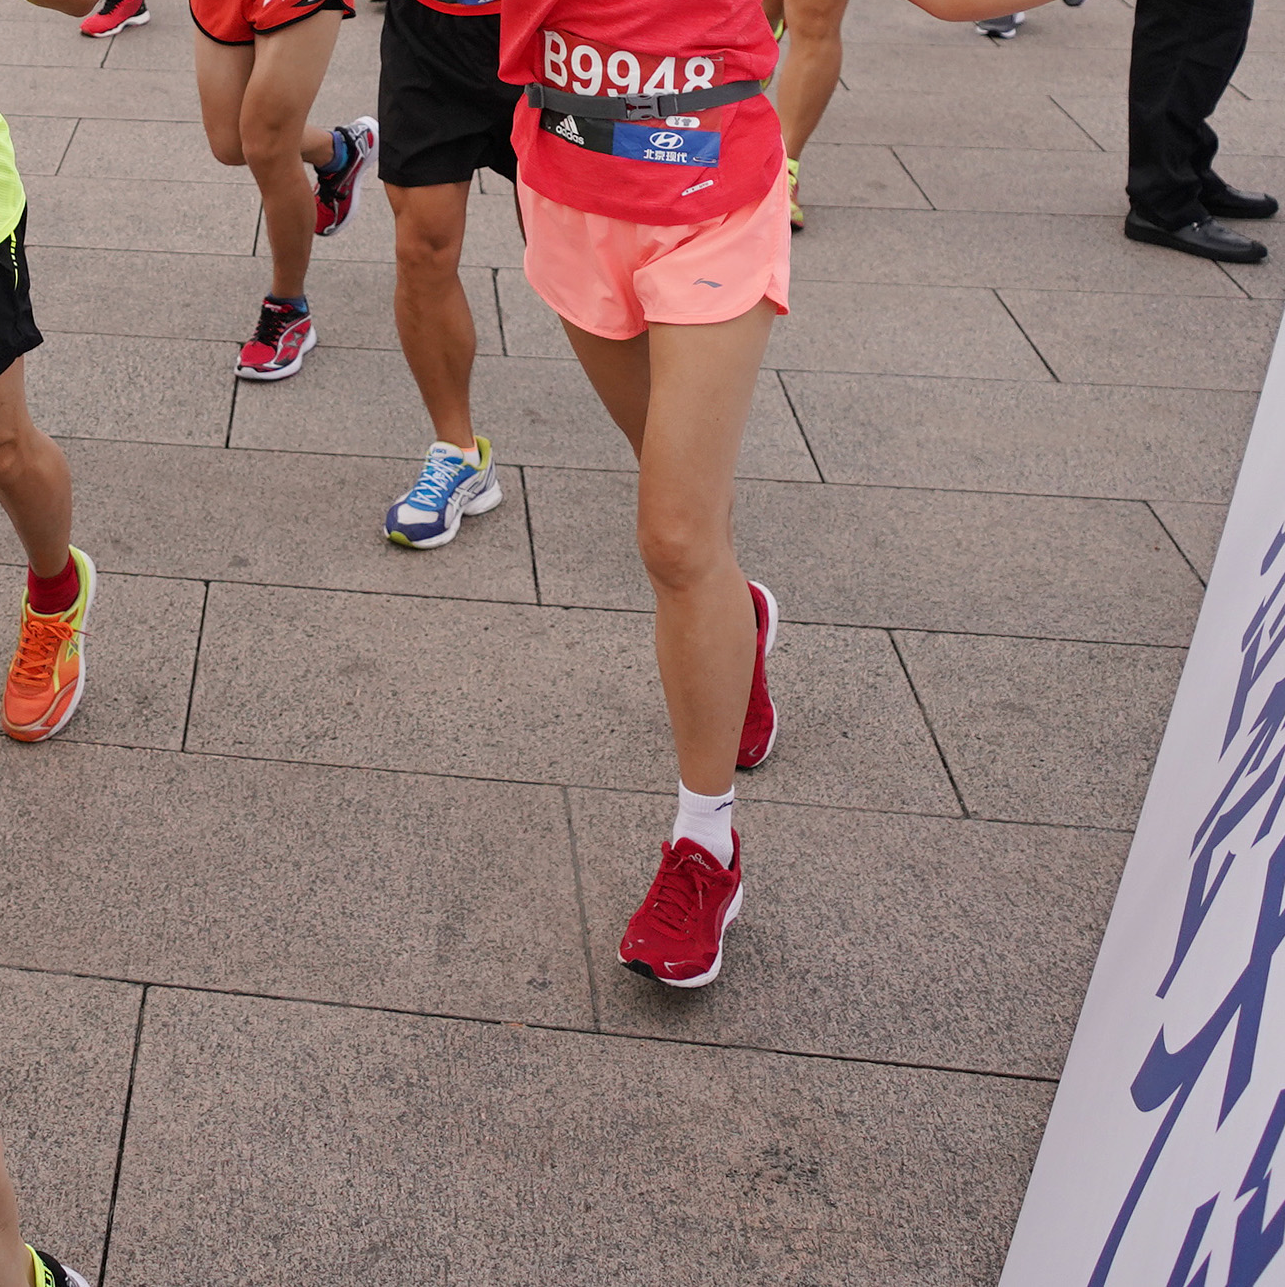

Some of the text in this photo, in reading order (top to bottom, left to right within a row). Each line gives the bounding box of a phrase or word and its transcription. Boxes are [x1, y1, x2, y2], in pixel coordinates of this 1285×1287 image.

[544, 29, 717, 100] B9948
[555, 124, 585, 146] adidas
[643, 148, 688, 164] 北京现代
